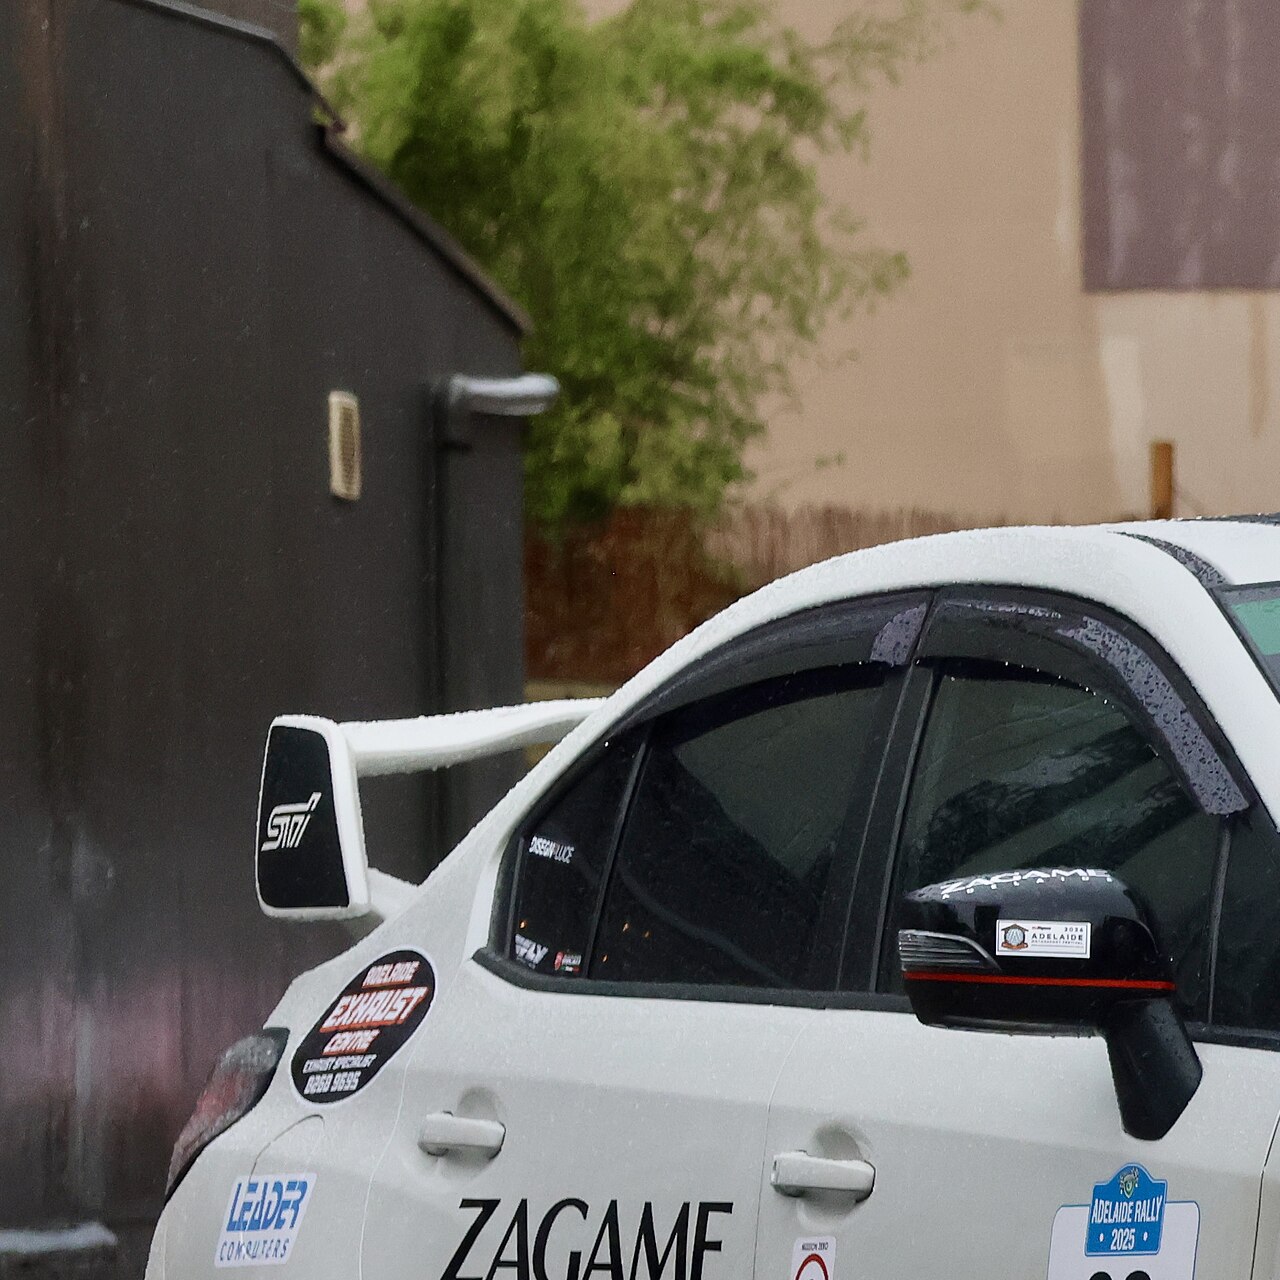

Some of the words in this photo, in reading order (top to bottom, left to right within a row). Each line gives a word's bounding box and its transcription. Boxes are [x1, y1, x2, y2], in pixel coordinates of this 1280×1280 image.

[939, 868, 1111, 895] ZAGAME
[1031, 933, 1084, 941] ADELAIDE
[319, 986, 429, 1033] EXHAUST
[226, 1180, 309, 1232] LEADER
[1091, 1198, 1134, 1224] ADELAIDE
[1134, 1195, 1163, 1222] RALLY
[219, 1238, 290, 1262] COMPUTERS
[1110, 1228, 1136, 1251] 2025
